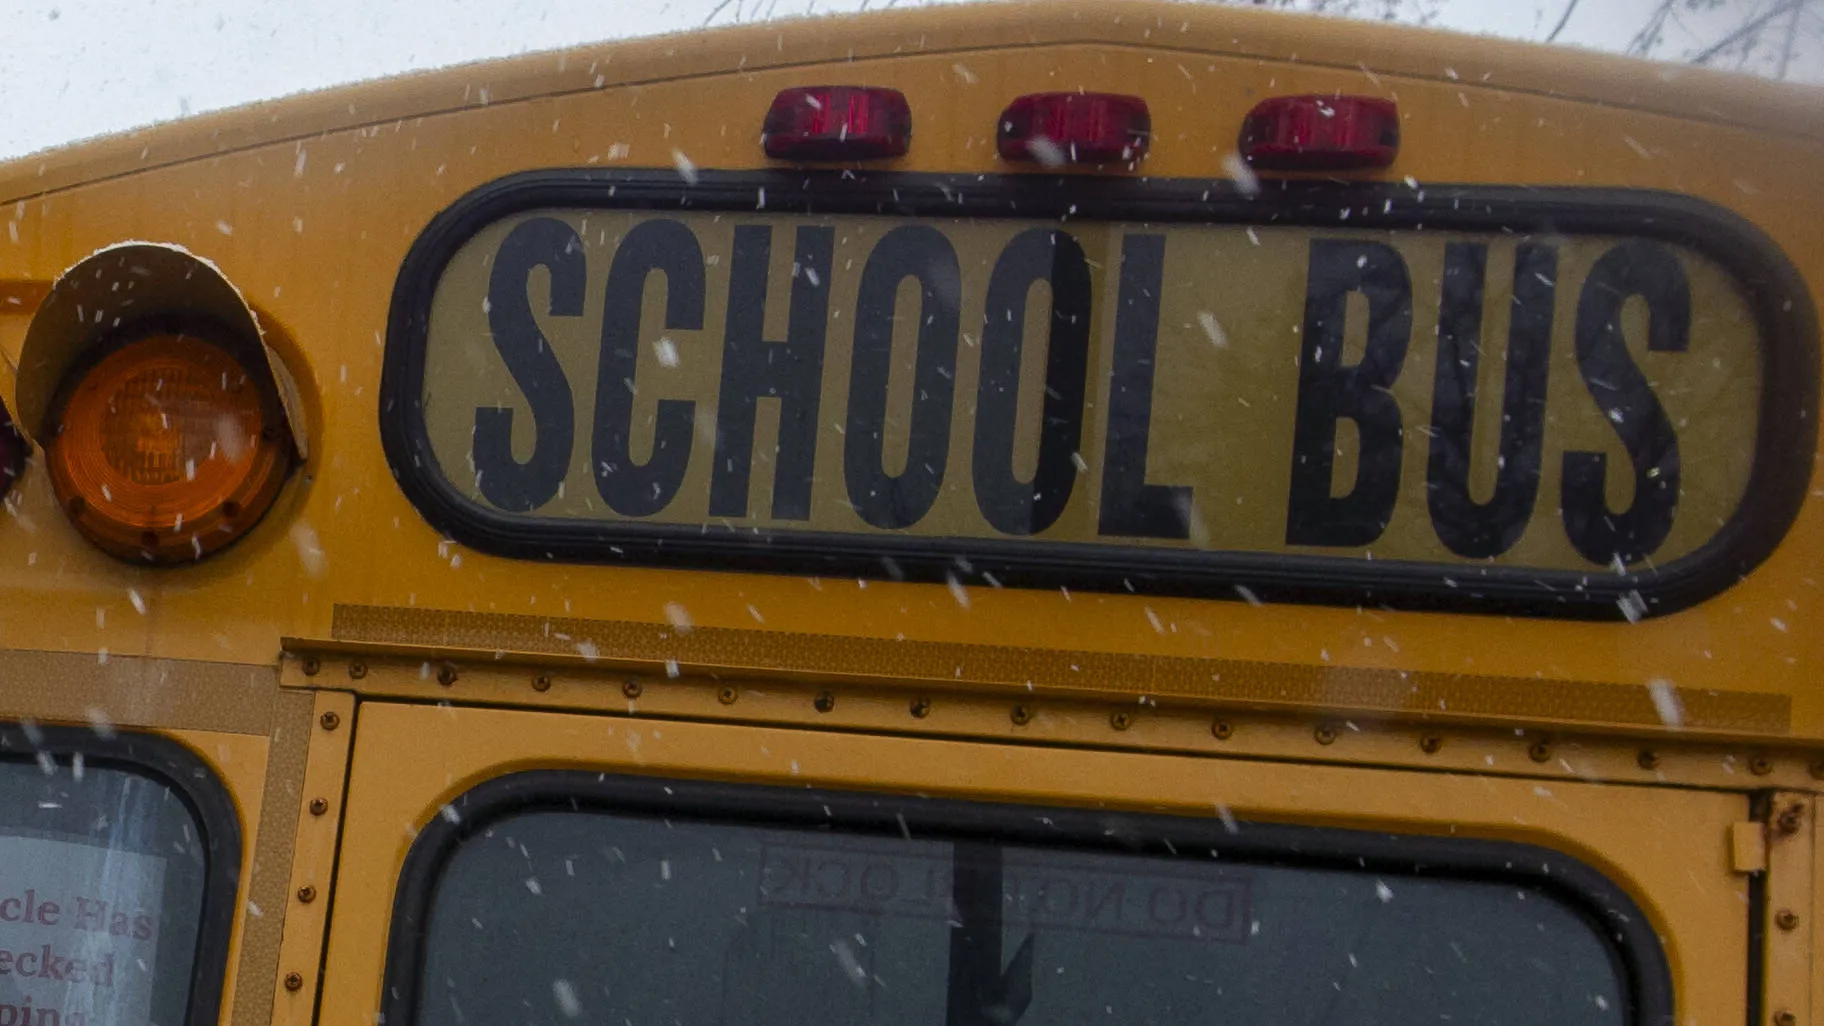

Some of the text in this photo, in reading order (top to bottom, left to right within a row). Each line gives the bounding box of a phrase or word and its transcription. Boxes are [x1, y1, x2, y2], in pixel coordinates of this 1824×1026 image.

[471, 216, 1693, 568] SCHOOL BUS
[74, 896, 154, 942] Has
